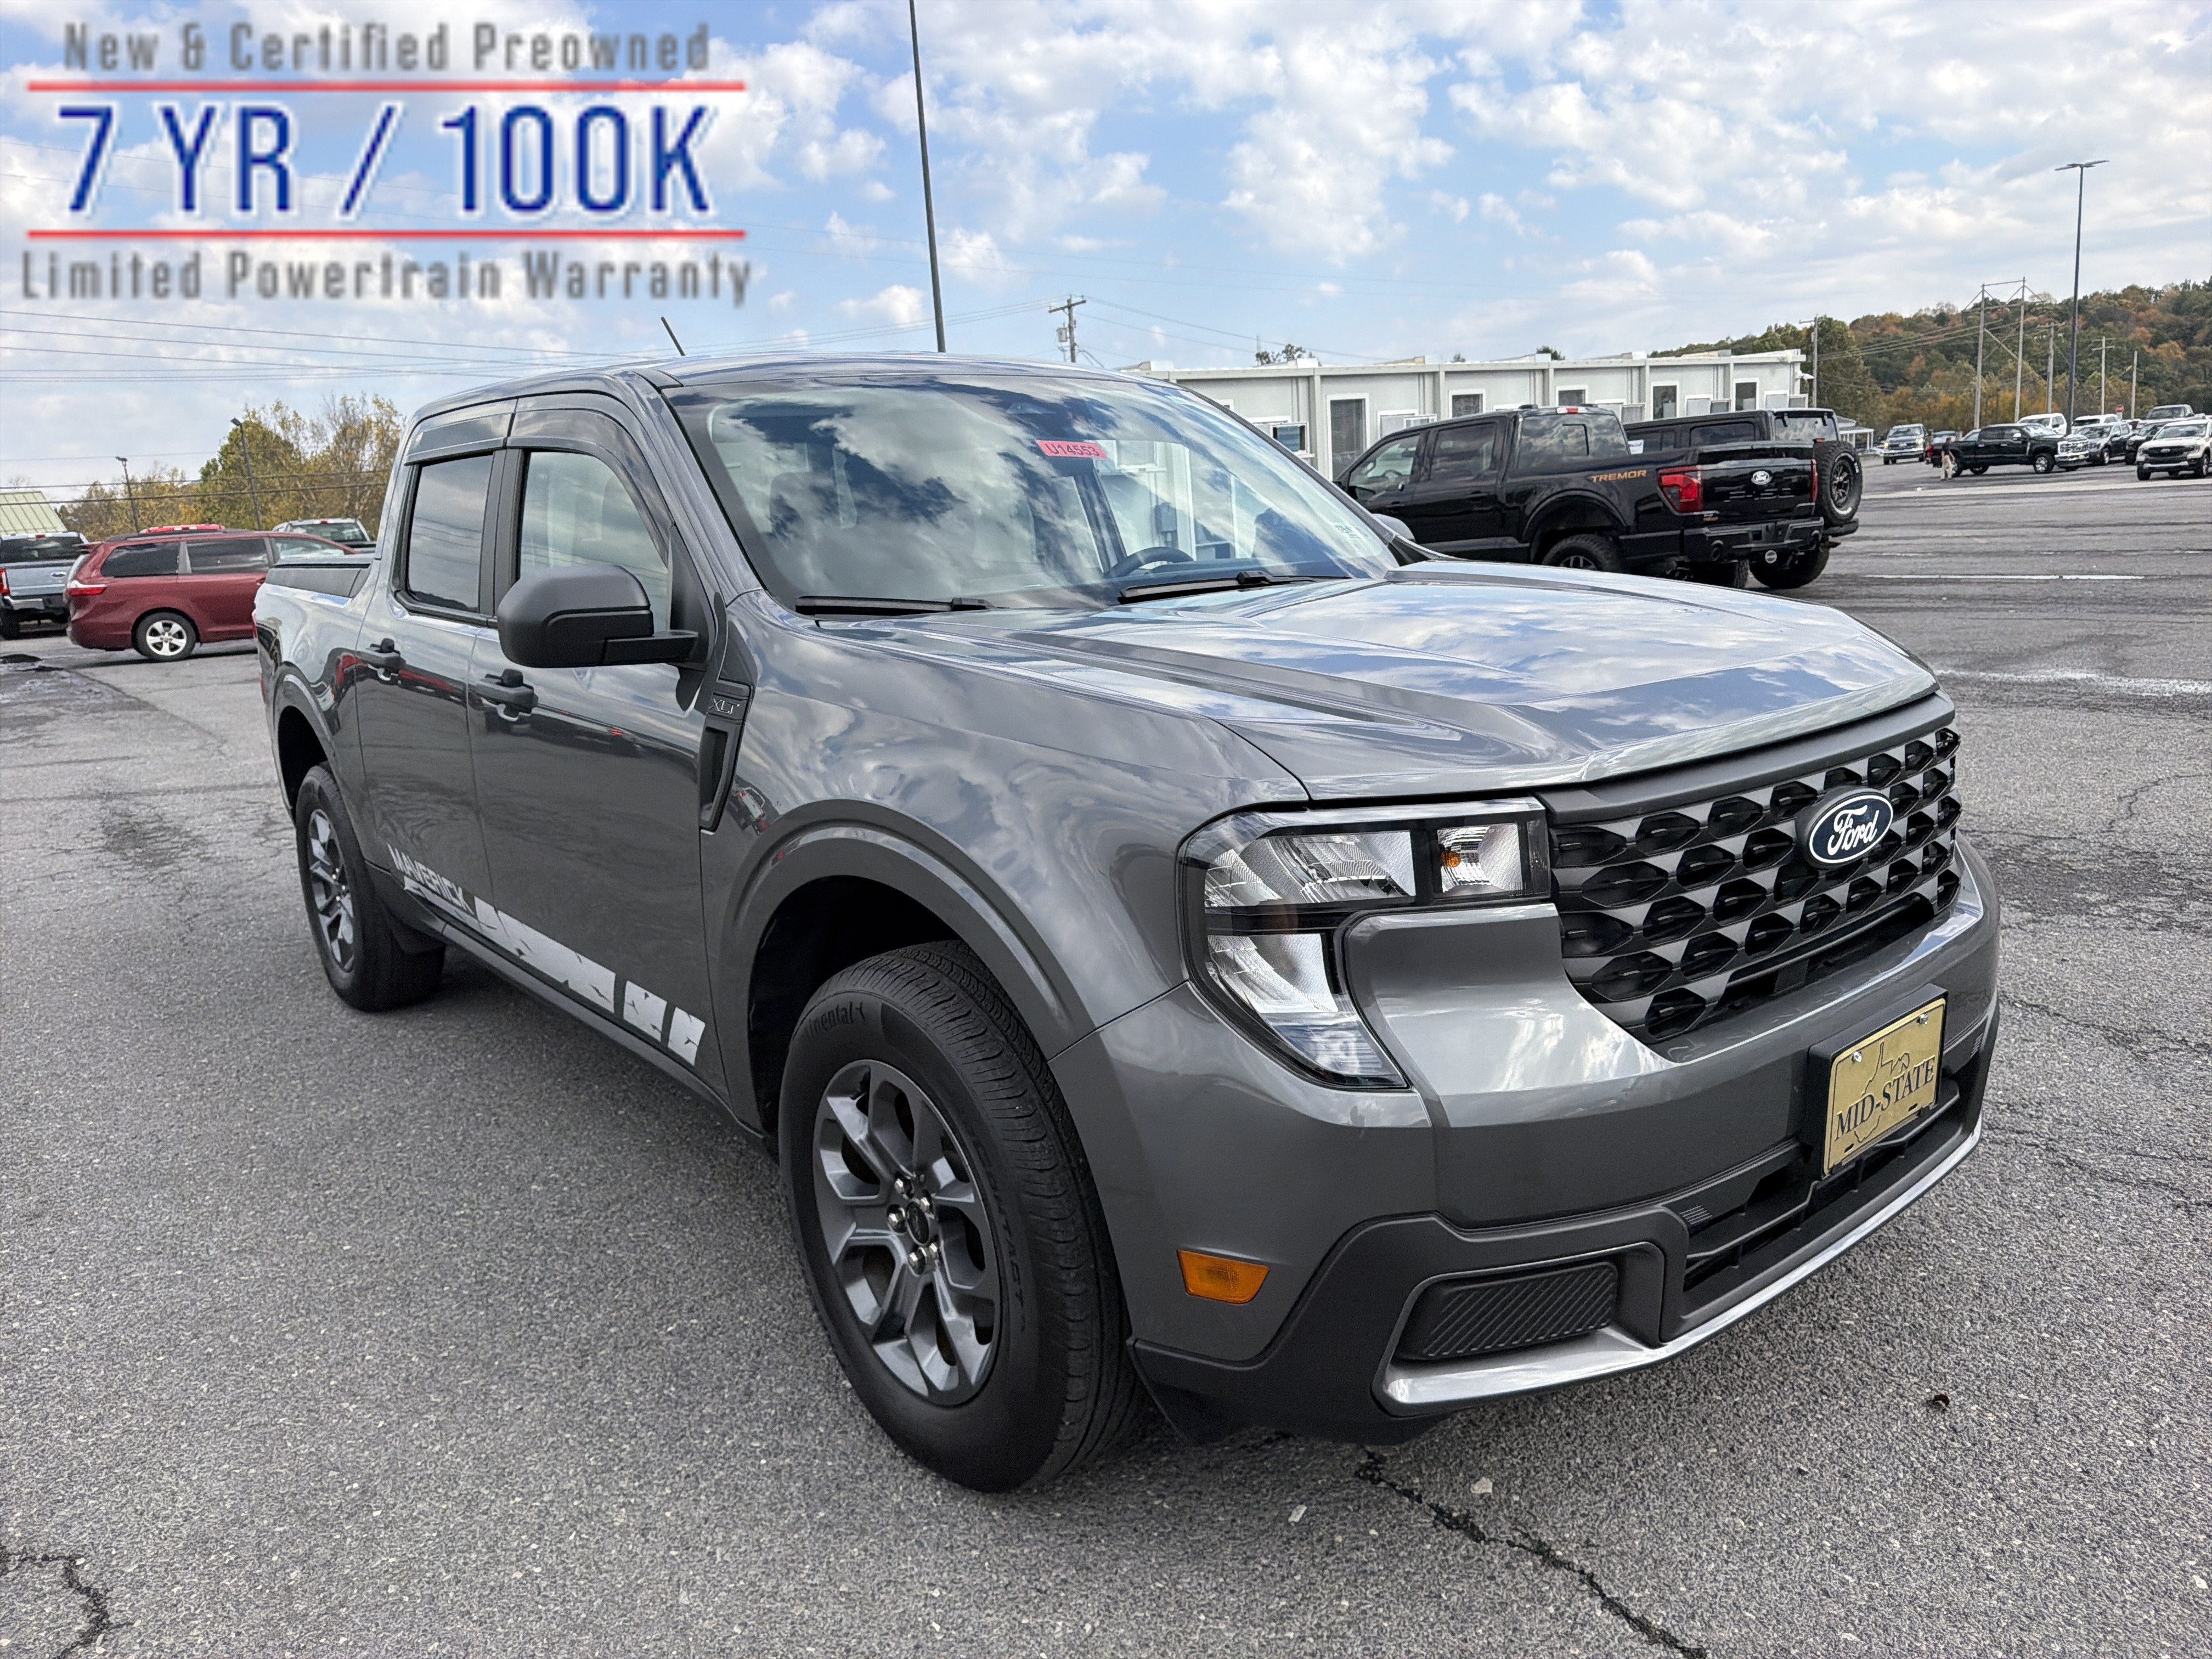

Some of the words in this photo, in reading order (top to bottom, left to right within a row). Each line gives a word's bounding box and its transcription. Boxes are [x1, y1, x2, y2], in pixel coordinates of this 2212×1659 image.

[1045, 443, 1101, 456] U14553
[1591, 470, 1647, 483] TREMOR
[708, 698, 740, 714] XLT
[1827, 805, 1880, 856] Ford
[387, 843, 475, 916] MAVERICK
[1835, 1054, 1936, 1142] MID-STATE
